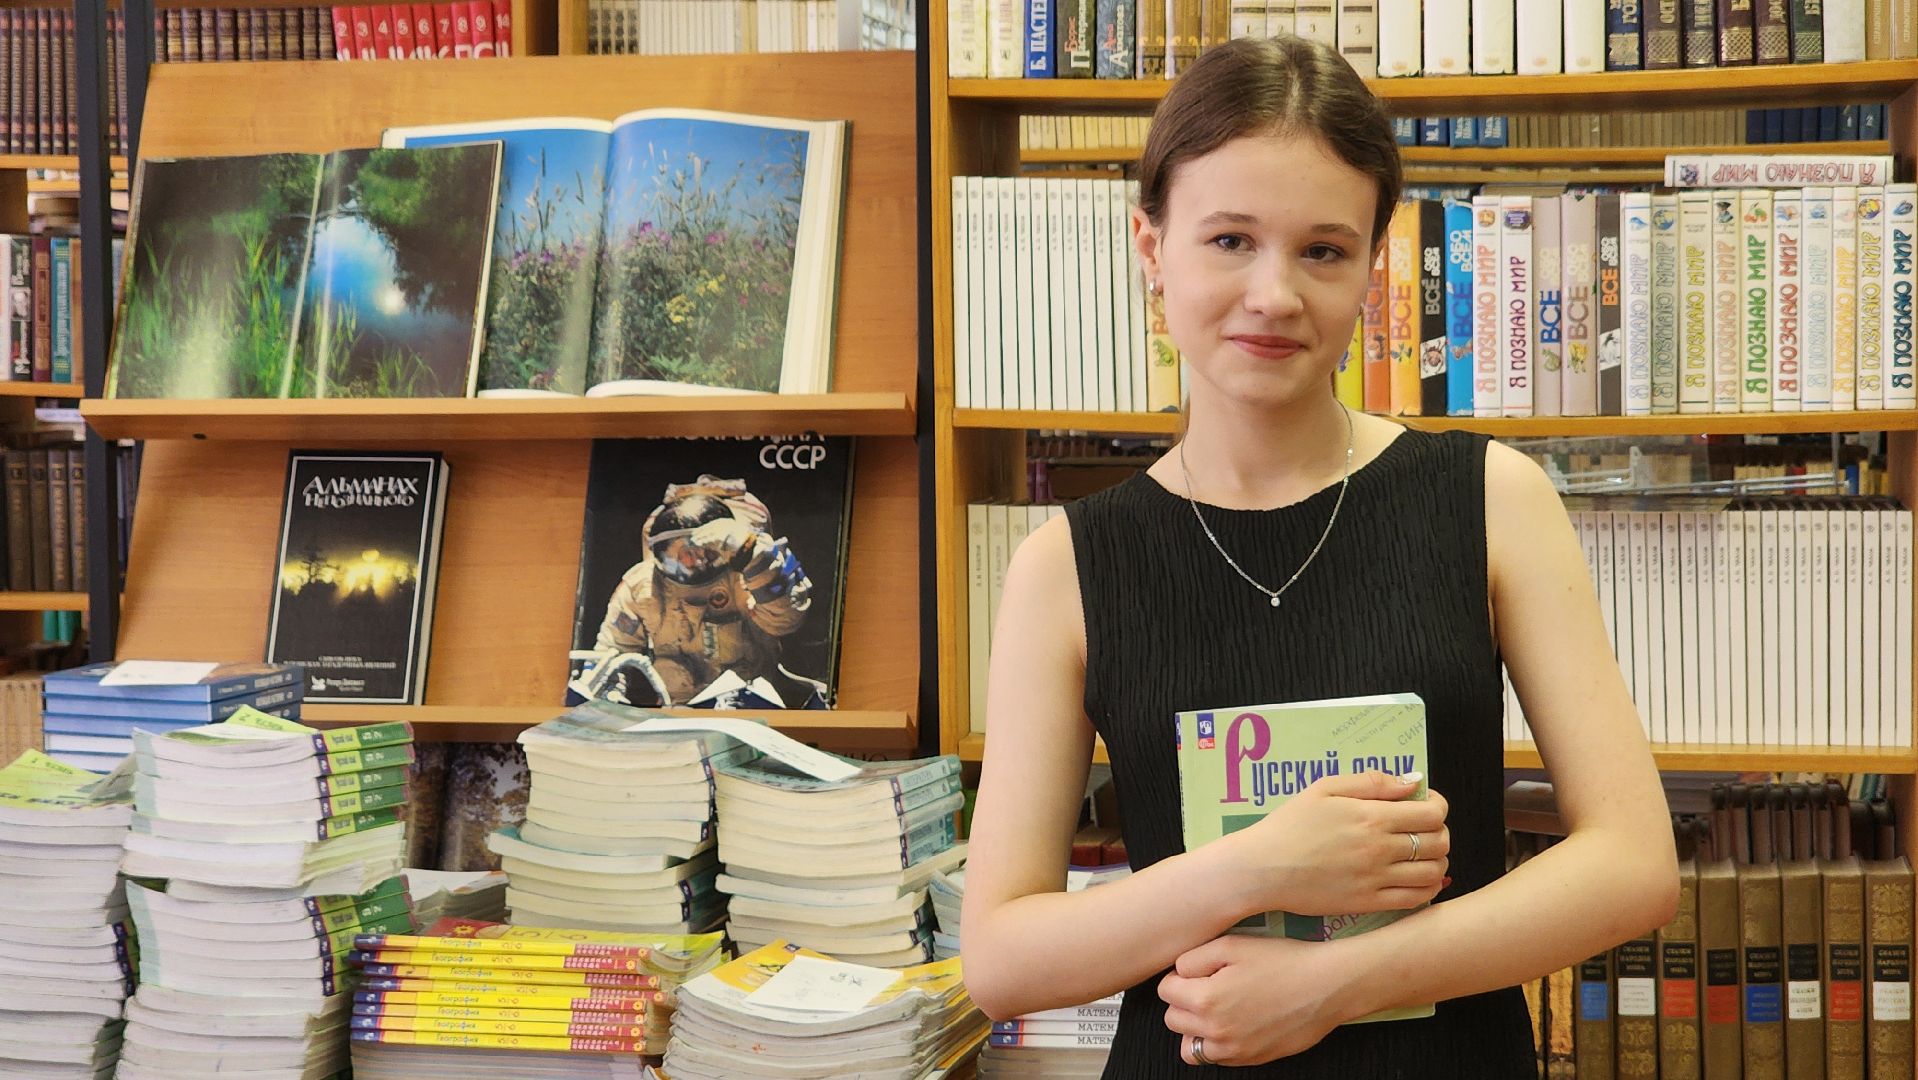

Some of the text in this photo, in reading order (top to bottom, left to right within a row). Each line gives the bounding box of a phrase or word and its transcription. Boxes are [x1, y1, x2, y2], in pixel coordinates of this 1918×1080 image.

[336, 21, 348, 37] 2
[357, 22, 368, 37] 3
[378, 20, 388, 34] 4
[397, 18, 409, 35] 5
[418, 18, 430, 35] 6
[439, 18, 449, 34] 7
[457, 16, 468, 33] 8
[475, 15, 486, 32] 9
[1711, 162, 1876, 185] Я ПОЗНАЮ МИР
[1746, 234, 1767, 281] МИР
[1779, 232, 1798, 277] МИР
[1685, 245, 1705, 388] Я ПОЗНАЮ МИР
[1807, 244, 1827, 388] Я ПОЗНАЮ МИР
[1860, 232, 1881, 391] Я ПОЗНАЮ МИР
[1892, 229, 1912, 389] Я ПОЗНАЮ МИР
[1476, 244, 1496, 393] Я ПОЗНАЮ МИР
[1510, 256, 1526, 388] Я ПОЗНАЮ МИР
[1629, 254, 1648, 399] Я ПОЗНАЮ МИР
[1654, 241, 1674, 398] Я ПОЗНАЮ МИР
[1716, 240, 1736, 396] Я ПОЗНАЮ МИР
[1834, 246, 1854, 393] Я ПОЗНАЮ МИР
[1746, 288, 1767, 373] ПОЗНАЮ
[1779, 283, 1798, 374] ПОЗНАЮ
[1745, 377, 1767, 393] Я
[1778, 378, 1798, 392] Я
[759, 445, 826, 470] СССР
[440, 938, 481, 949] География
[432, 954, 473, 964] География
[451, 967, 492, 978] География
[455, 982, 497, 993] География
[437, 995, 479, 1005] География
[438, 1007, 480, 1018] География
[434, 1020, 476, 1030] География
[437, 1035, 478, 1045] География
